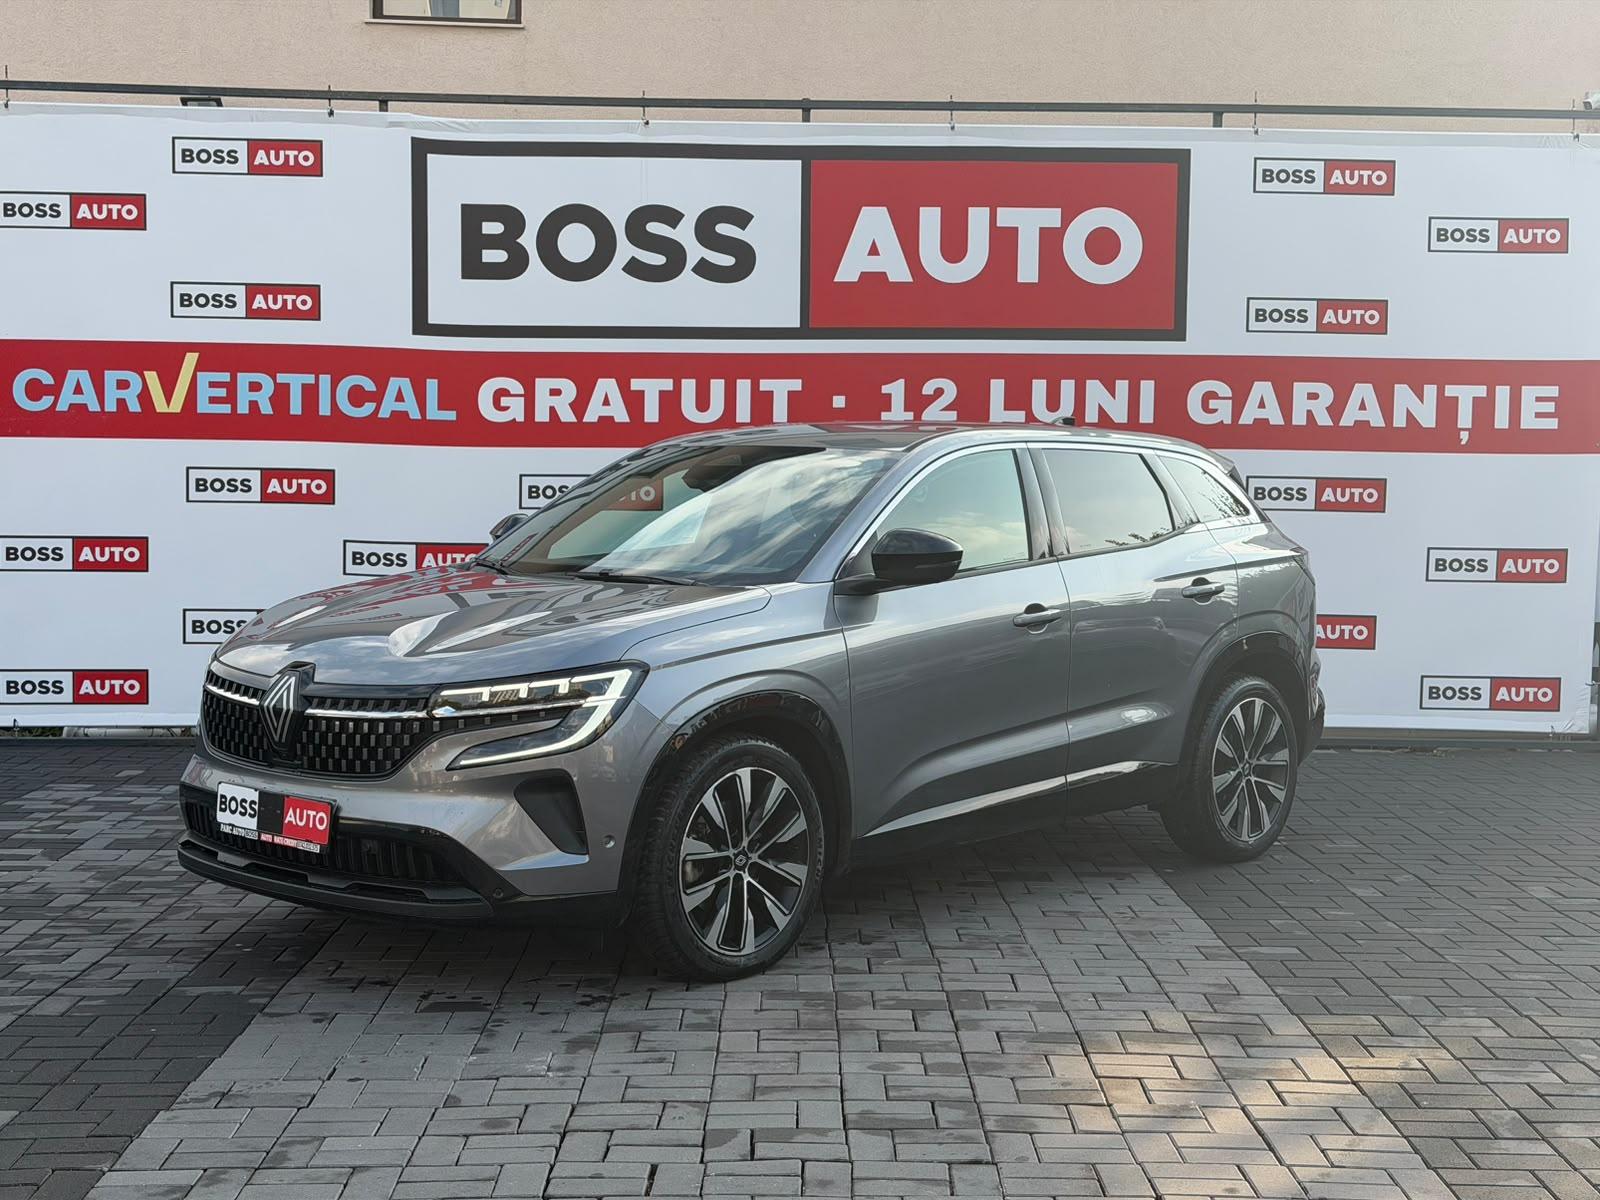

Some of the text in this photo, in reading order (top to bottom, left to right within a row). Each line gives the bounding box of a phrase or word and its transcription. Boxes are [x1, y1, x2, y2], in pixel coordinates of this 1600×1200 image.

[182, 148, 315, 167] BOSS AUTO
[1261, 168, 1388, 186] BOSS AUTO
[2, 202, 138, 221] BOSS AUTO
[461, 203, 1143, 285] BOSS AUTO
[1436, 227, 1561, 244] BOSS AUTO
[179, 293, 313, 311] BOSS AUTO
[1254, 308, 1380, 325] BOSS AUTO
[12, 352, 457, 421] CARVERTICAL
[477, 377, 802, 424] GRATUIT
[880, 378, 958, 421] 12
[989, 379, 1155, 424] LUNI
[1186, 380, 1560, 445] GARANȚIE
[194, 477, 327, 495] BOSS AUTO
[1253, 486, 1379, 504] BOSS AUTO
[5, 546, 140, 563] BOSS AUTO
[352, 551, 408, 567] BOSS
[1434, 557, 1560, 574] BOSS AUTO
[5, 679, 140, 696] BOSS AUTO
[1428, 685, 1553, 703] BOSS AUTO
[218, 794, 328, 831] BOSS AUTO
